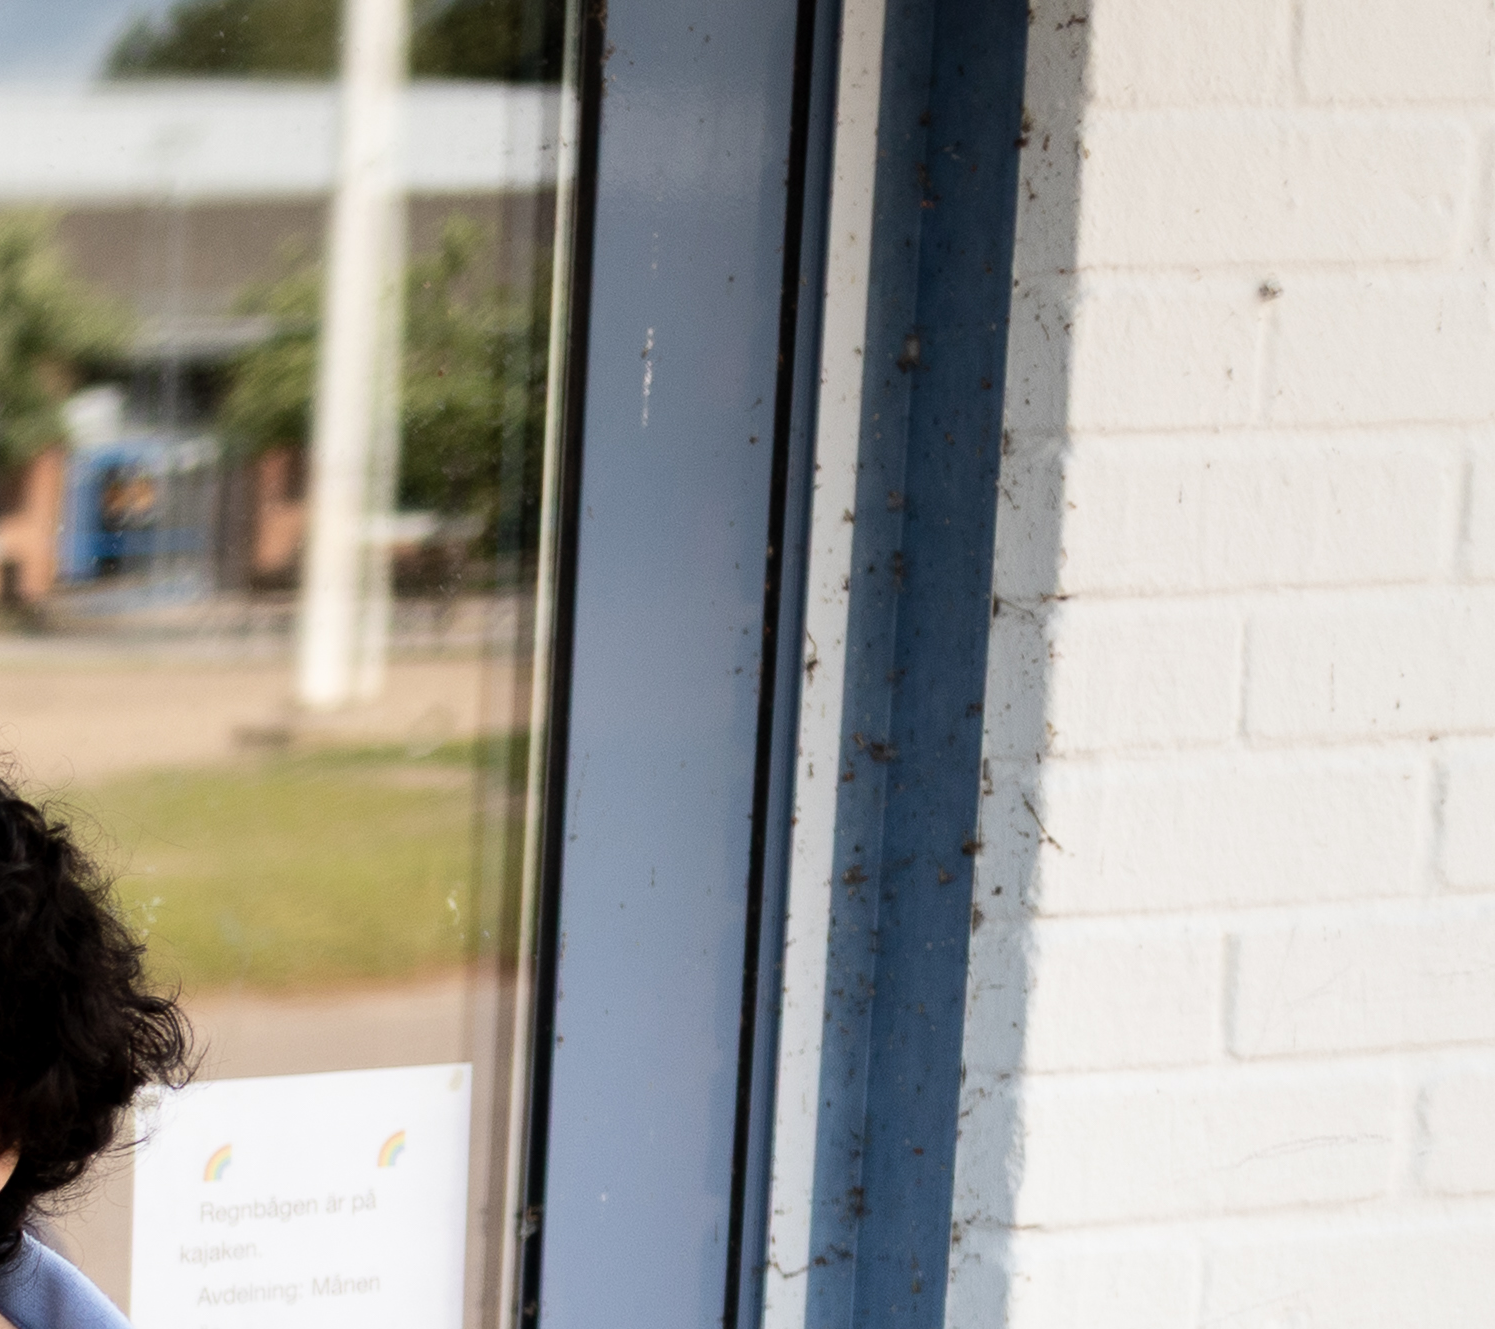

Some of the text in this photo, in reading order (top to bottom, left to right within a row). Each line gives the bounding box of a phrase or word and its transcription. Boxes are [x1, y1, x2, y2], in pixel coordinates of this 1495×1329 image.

[200, 1188, 378, 1226] Regnbågen är på
[196, 1273, 382, 1308] Avdelning: Månen
